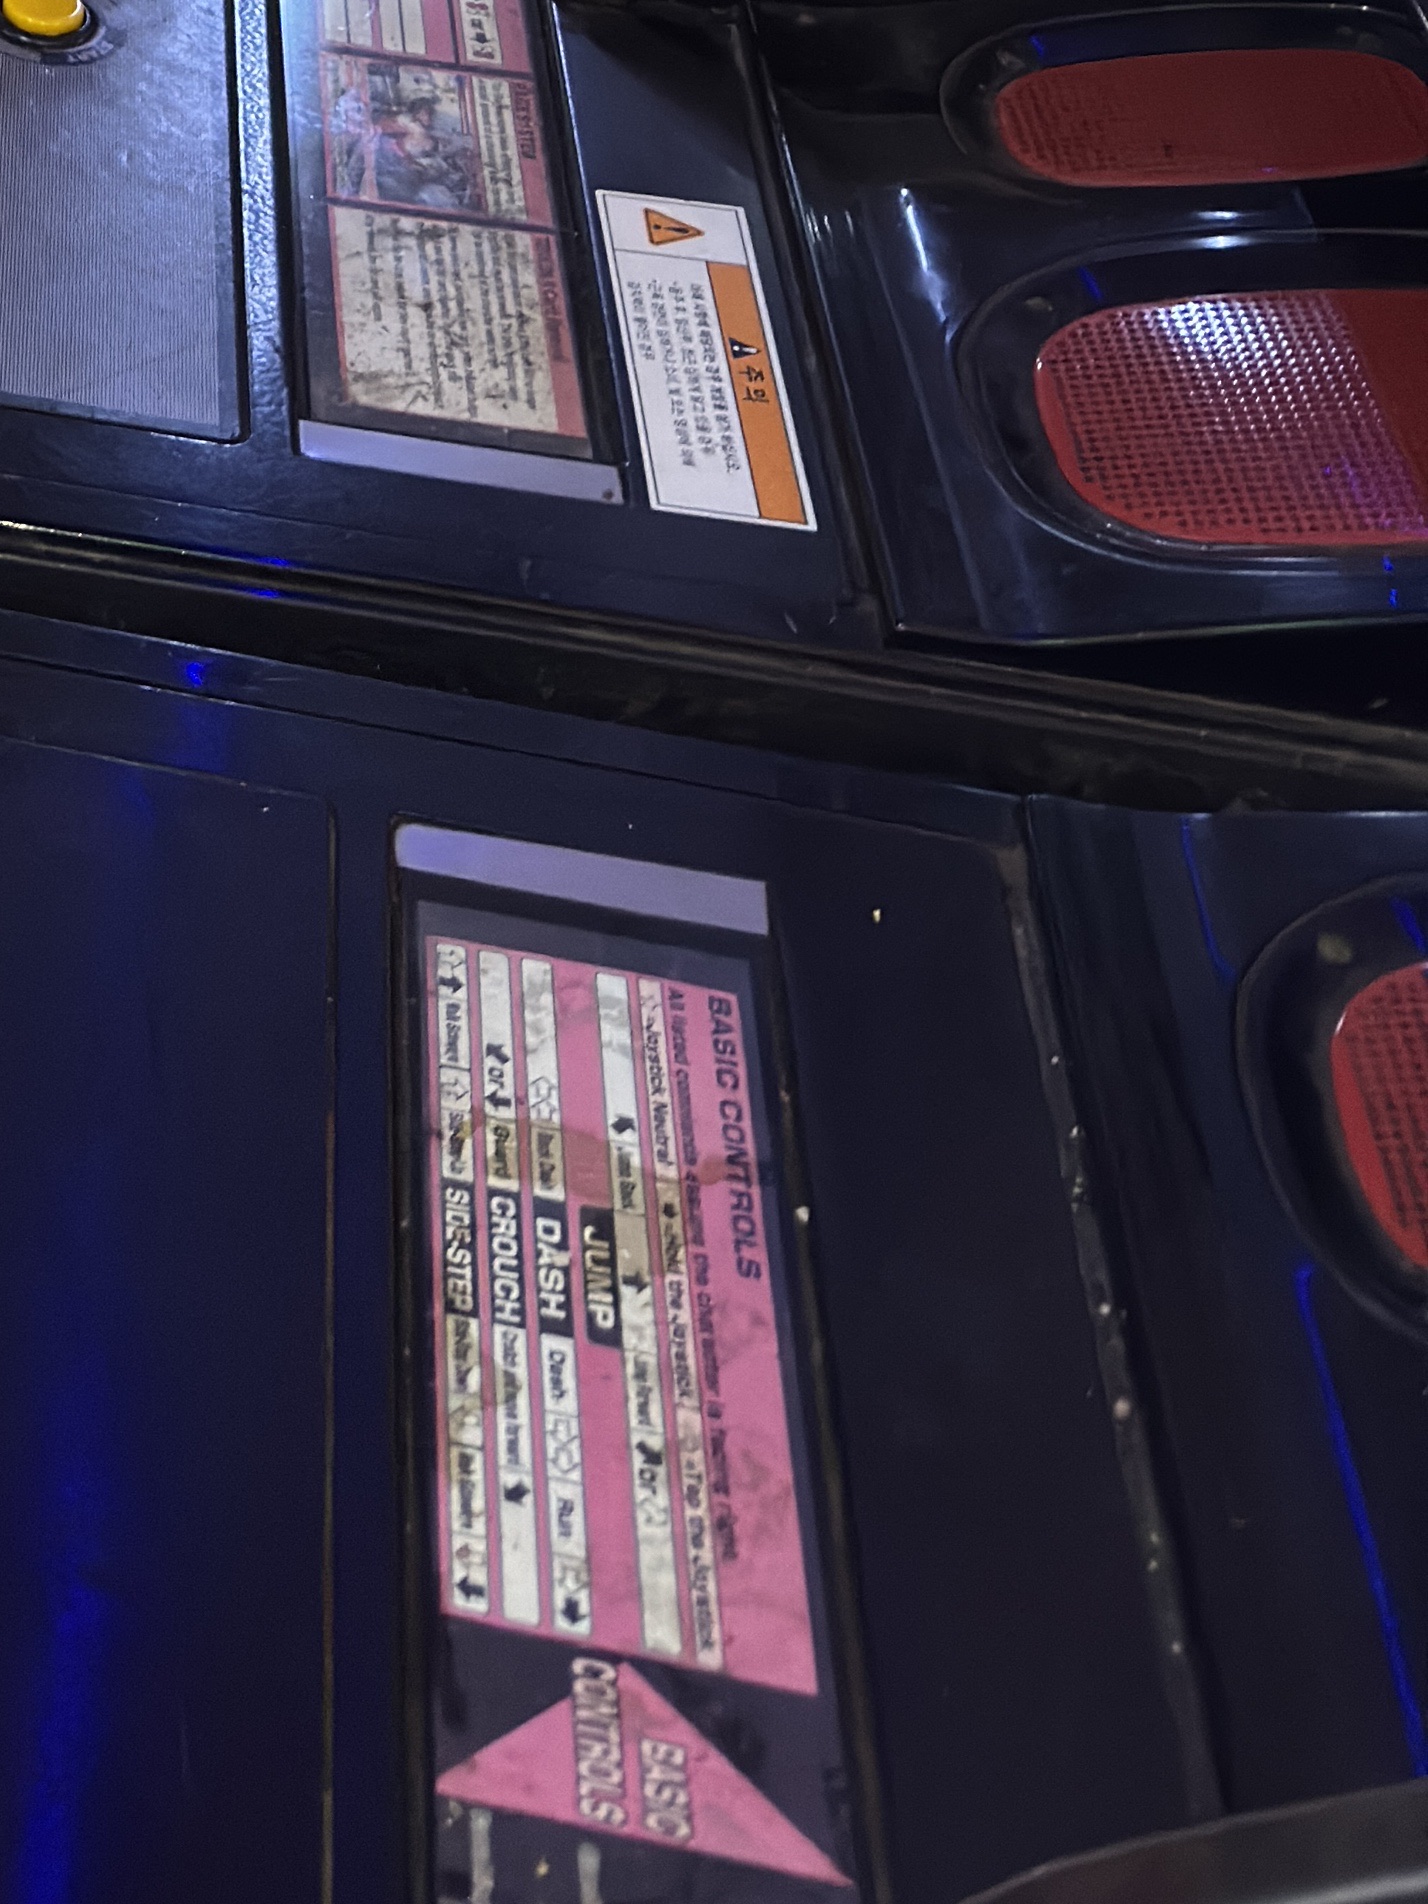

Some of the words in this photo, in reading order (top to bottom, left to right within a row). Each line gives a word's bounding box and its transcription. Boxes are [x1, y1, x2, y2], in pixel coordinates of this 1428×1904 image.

[735, 364, 769, 404] 주의
[487, 1064, 505, 1090] or
[707, 994, 741, 1091] BASIC
[491, 1124, 512, 1181] Guard
[651, 1099, 675, 1167] Neutral
[717, 1097, 762, 1281] CONTROLS
[443, 1184, 474, 1313] SIDE-STEP
[489, 1193, 523, 1325] CROUCH
[534, 1214, 567, 1322] DASH
[581, 1222, 617, 1332] JUMP
[667, 1276, 685, 1311] the
[547, 1347, 569, 1403] Dash
[668, 1310, 693, 1399] Joystick
[555, 1496, 576, 1540] Run
[637, 1466, 659, 1496] or
[687, 1552, 717, 1652] Joystick
[571, 1656, 628, 1830] CONTROLS
[642, 1738, 694, 1845] BASIC
